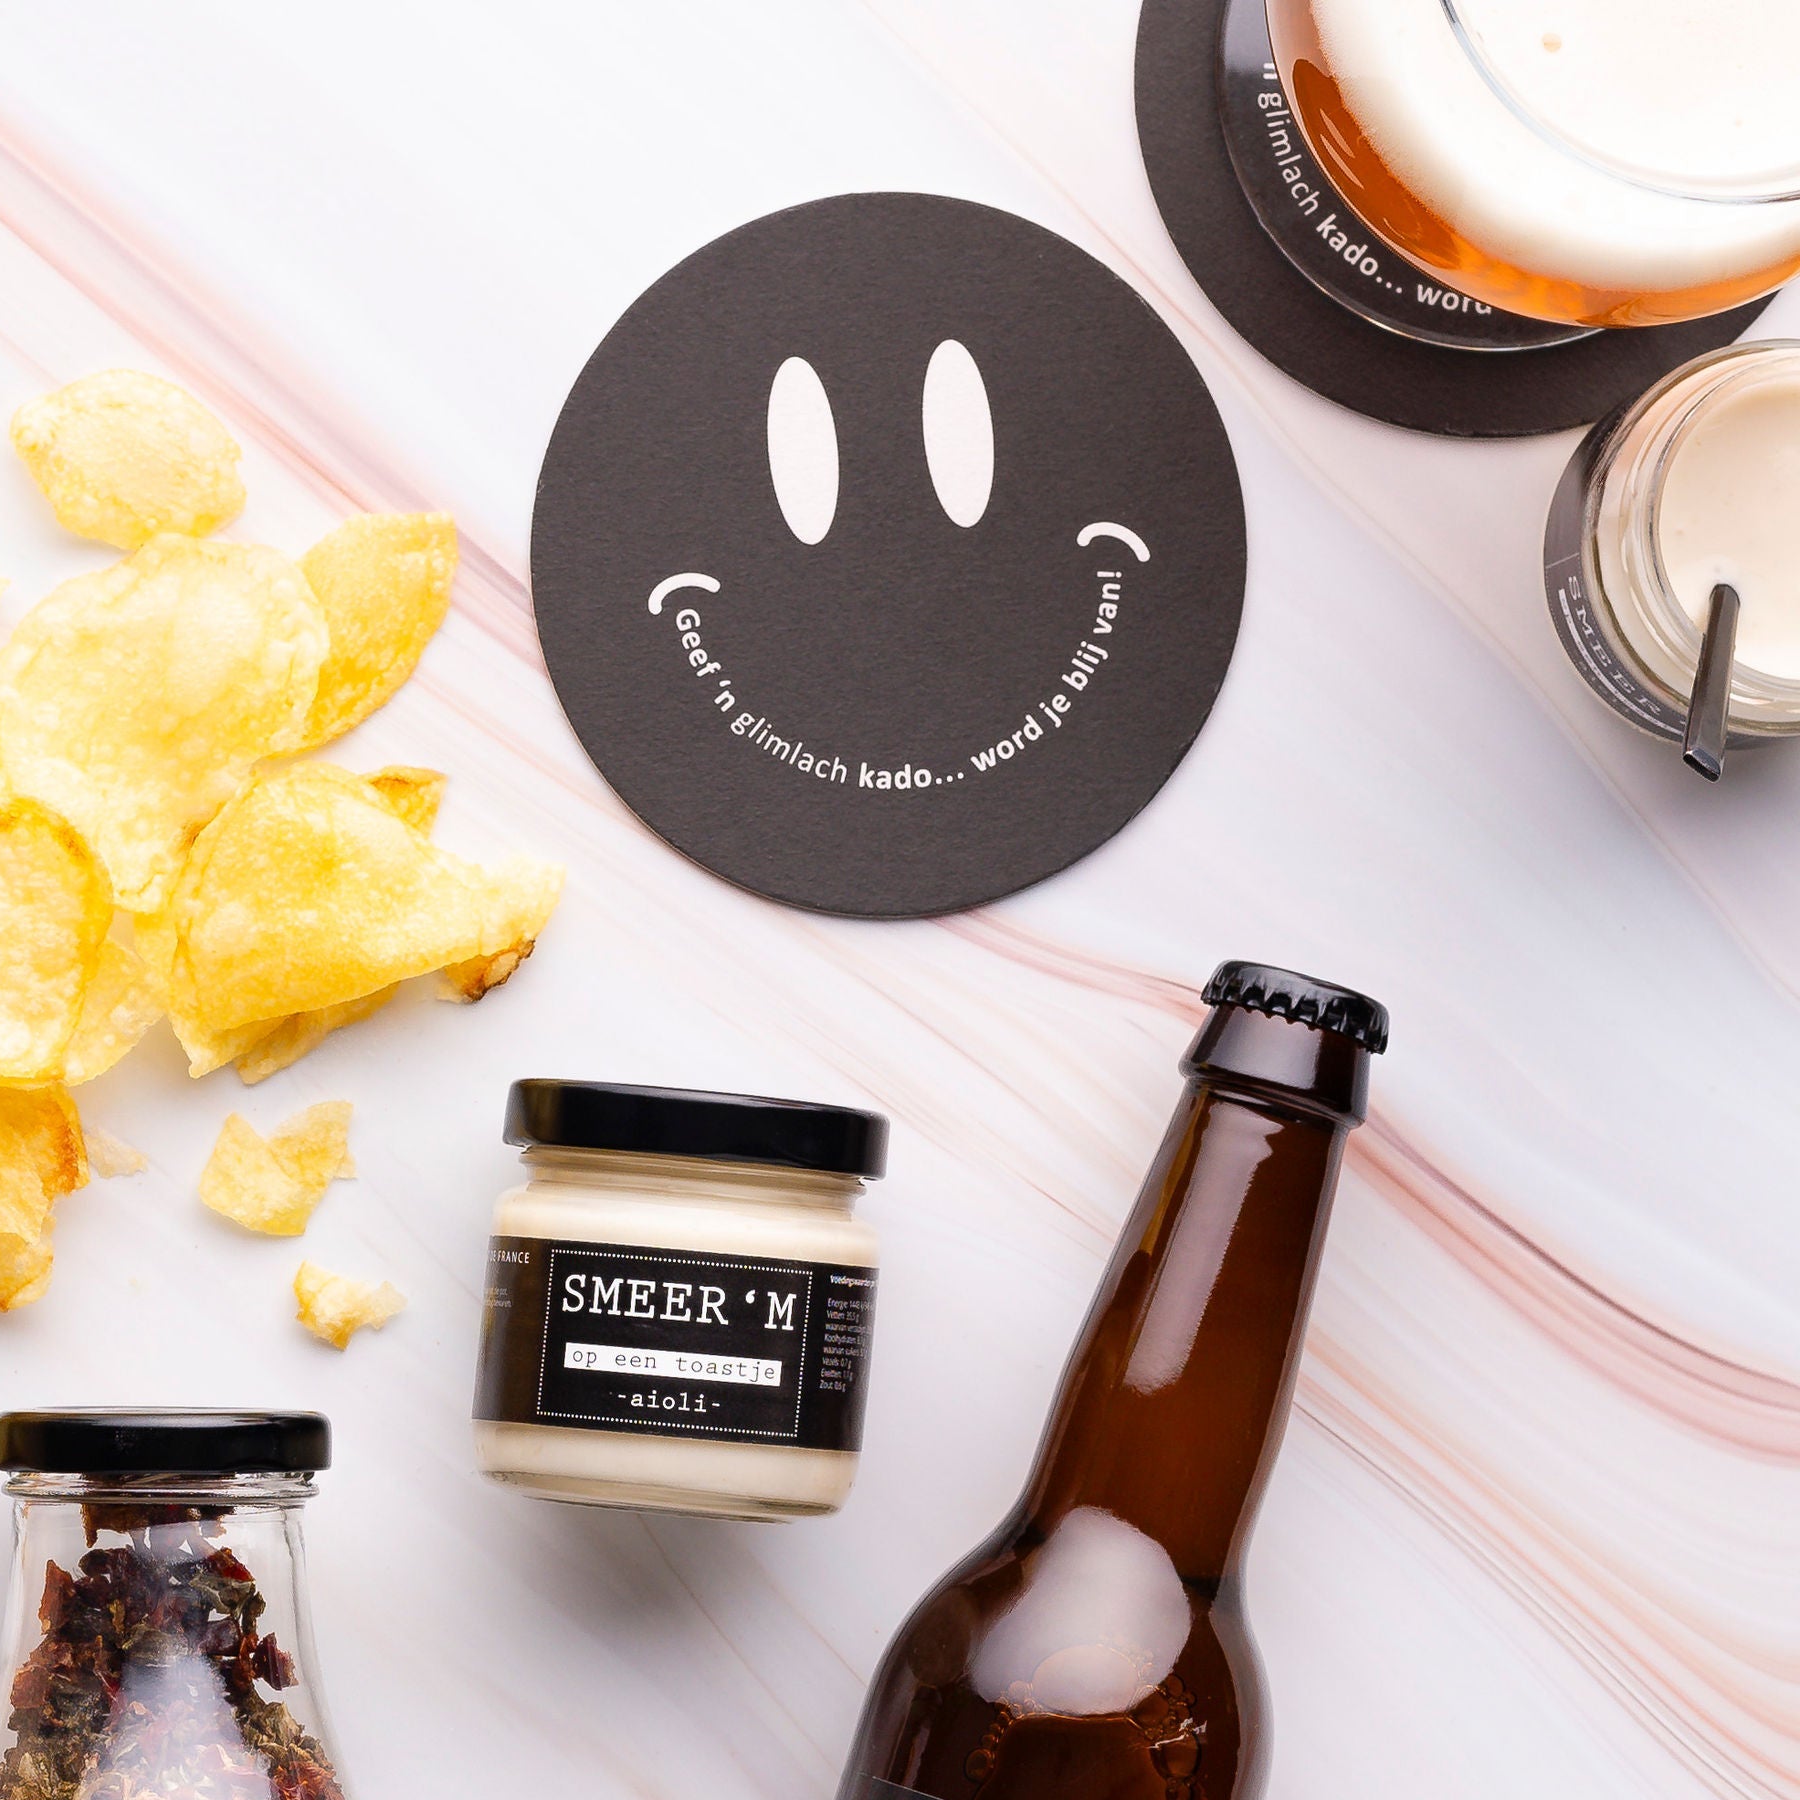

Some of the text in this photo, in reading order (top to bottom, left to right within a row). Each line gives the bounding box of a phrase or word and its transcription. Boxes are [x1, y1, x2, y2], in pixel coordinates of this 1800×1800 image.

[1257, 91, 1318, 217] glimlach
[1315, 213, 1403, 294] kado...
[675, 608, 721, 677] Geef
[730, 711, 848, 783] glimlach
[859, 762, 965, 790] kado...
[970, 715, 1044, 774] word
[1038, 693, 1071, 728] je
[1062, 640, 1109, 691] blij
[1092, 570, 1123, 635] van!
[561, 1273, 729, 1326] SMEER
[571, 1349, 777, 1384] op een toastje
[617, 1390, 722, 1414] -aioli-
